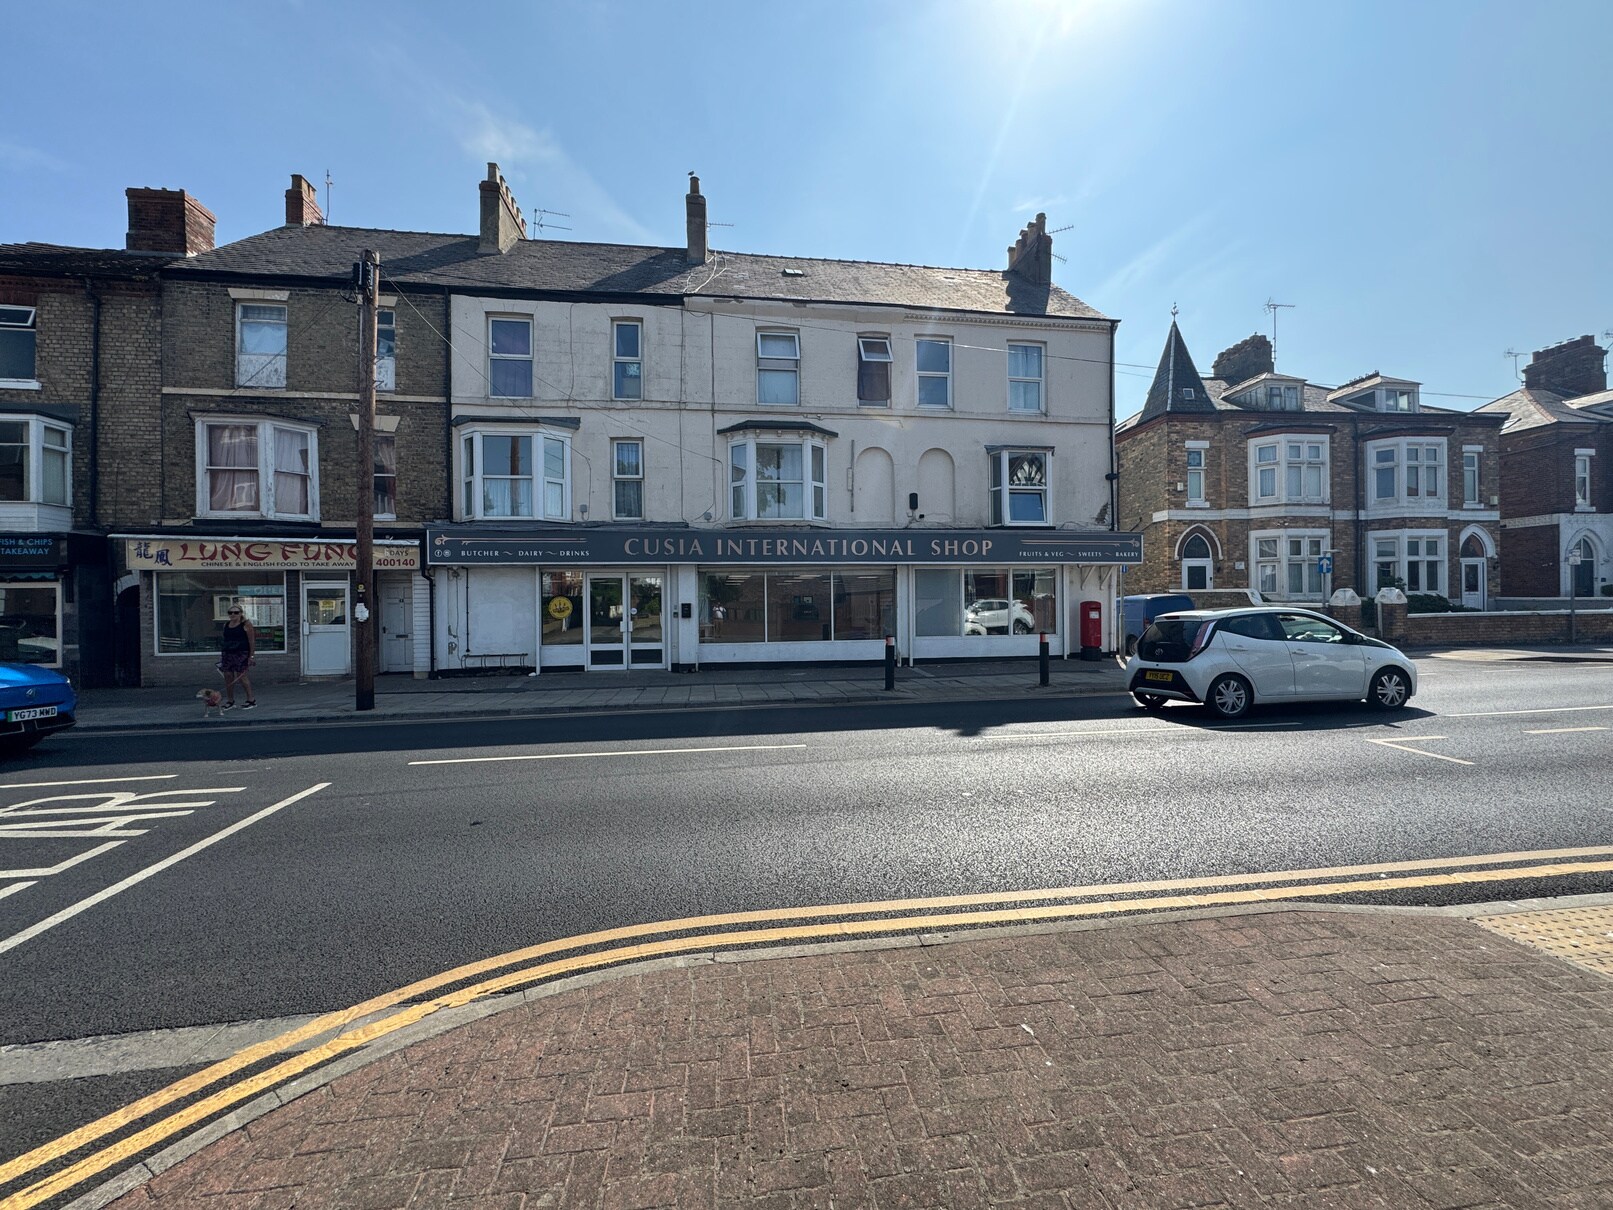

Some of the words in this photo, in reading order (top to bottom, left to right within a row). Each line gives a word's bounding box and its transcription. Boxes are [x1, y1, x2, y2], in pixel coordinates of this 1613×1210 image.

[18, 538, 24, 546] &
[26, 538, 53, 546] CHIPS
[623, 538, 704, 556] CUSIA
[716, 538, 916, 556] INTERNATIONAL
[930, 539, 993, 556] SHOP
[0, 547, 50, 555] TAKEAWAY
[133, 541, 173, 566] 龍鳳
[177, 543, 273, 561] LUNG
[375, 558, 415, 567] 400140
[14, 709, 38, 720] YG73
